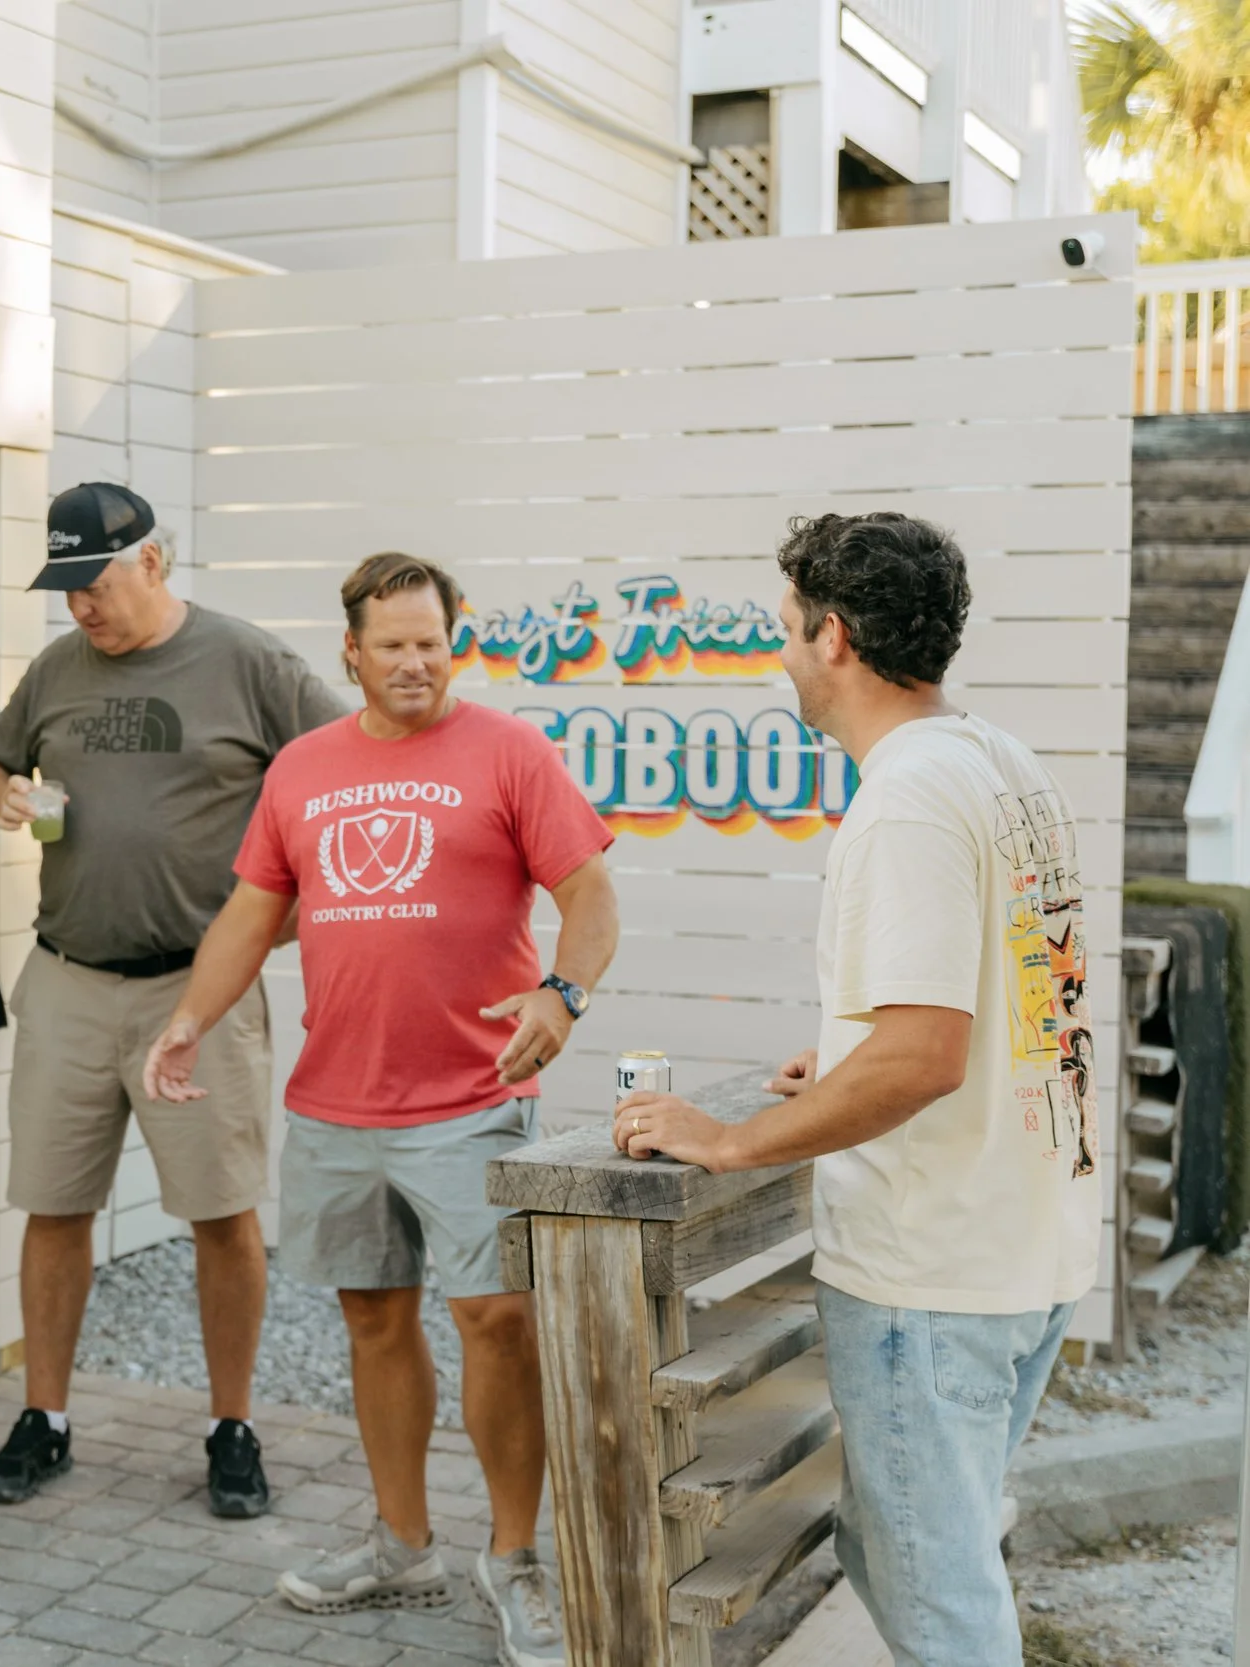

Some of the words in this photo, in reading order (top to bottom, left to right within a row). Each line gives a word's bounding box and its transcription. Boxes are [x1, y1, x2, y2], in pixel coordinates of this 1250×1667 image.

[450, 579, 605, 681] rayt
[614, 574, 790, 680] Frien
[103, 696, 146, 716] THE
[66, 715, 143, 737] NORTH
[82, 733, 140, 755] FACE
[303, 780, 463, 822] BUSHWOOD
[311, 904, 386, 924] COUNTRY
[387, 903, 438, 919] CLUB
